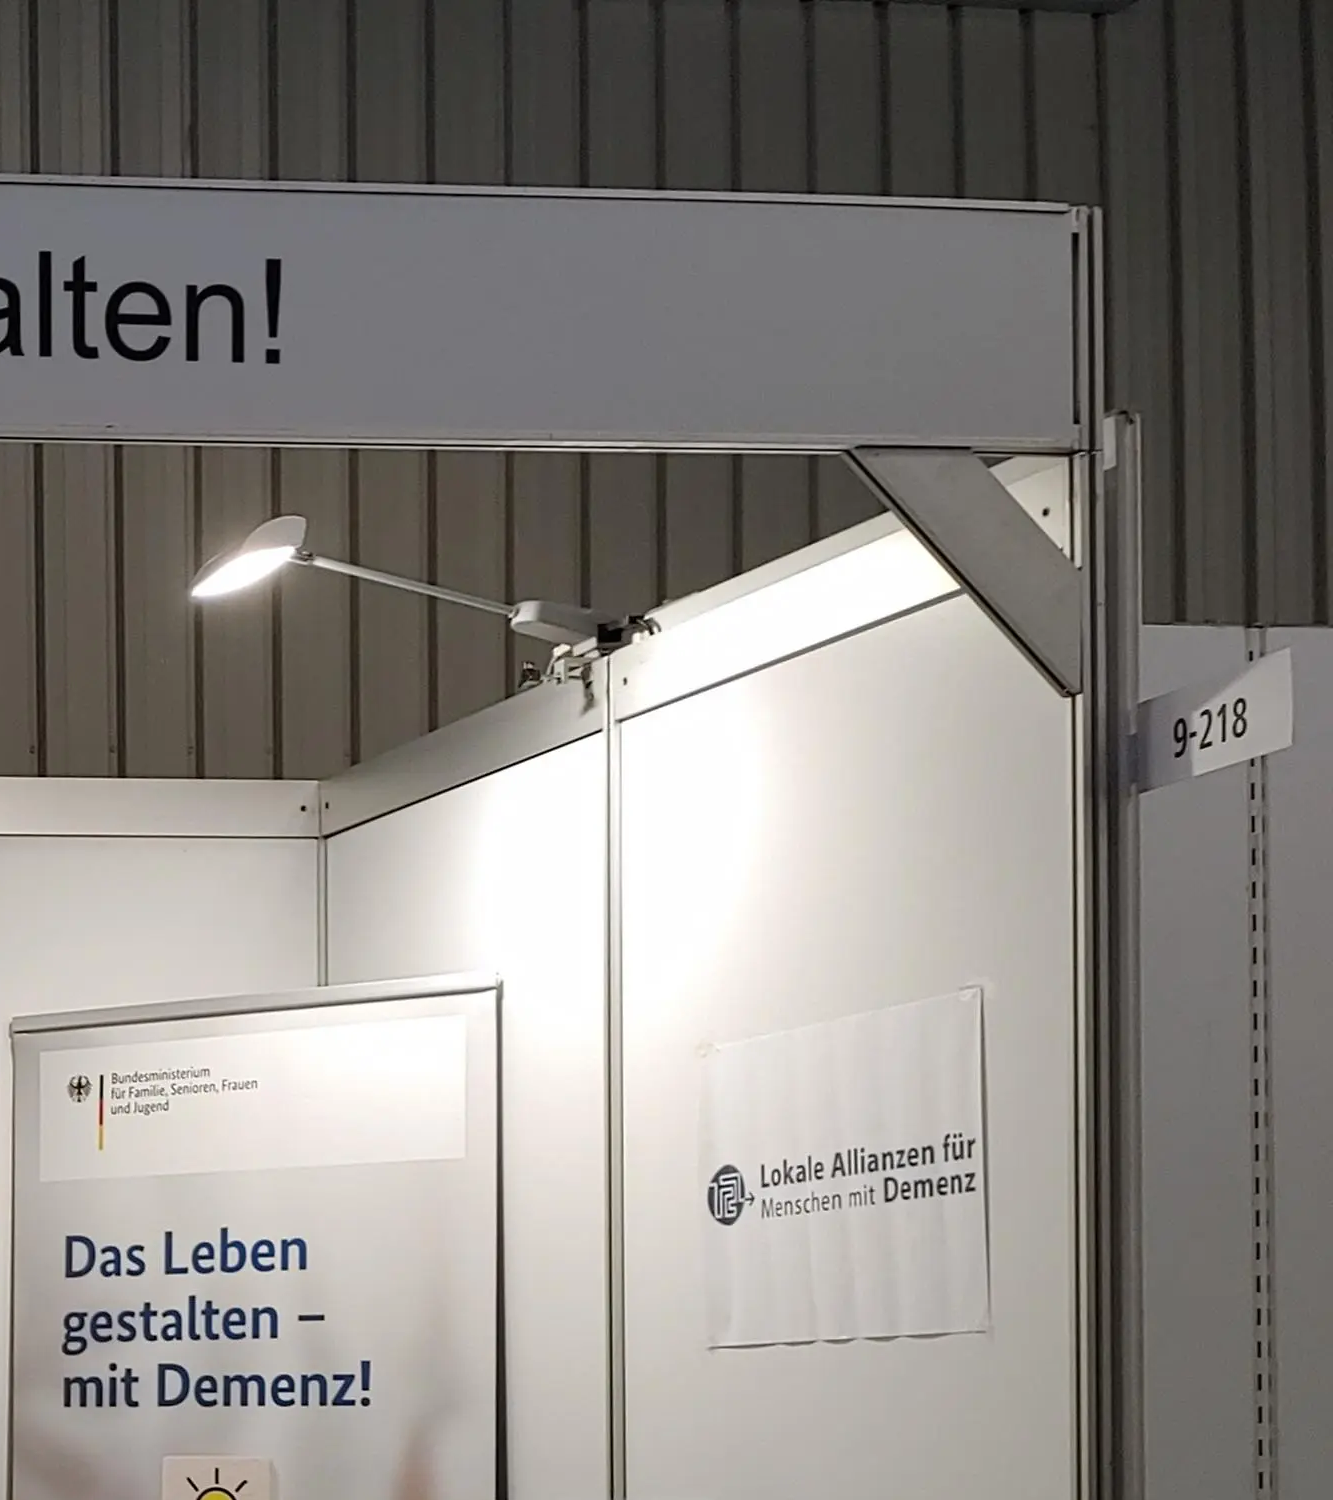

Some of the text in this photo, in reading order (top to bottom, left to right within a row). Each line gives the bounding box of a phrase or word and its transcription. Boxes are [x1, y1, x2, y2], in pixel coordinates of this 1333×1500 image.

[1173, 698, 1247, 758] 9-218
[111, 1065, 211, 1085] Bundesministerium
[111, 1077, 258, 1099] für Familie, Senioren, Frauen
[111, 1100, 169, 1117] und Jugend
[760, 1132, 976, 1188] Lokale Allianzen für
[761, 1172, 976, 1219] Menschen mit Demenz
[65, 1227, 307, 1278] Das Leben
[61, 1295, 279, 1356] gestalten
[63, 1360, 371, 1408] mit Demenz!
